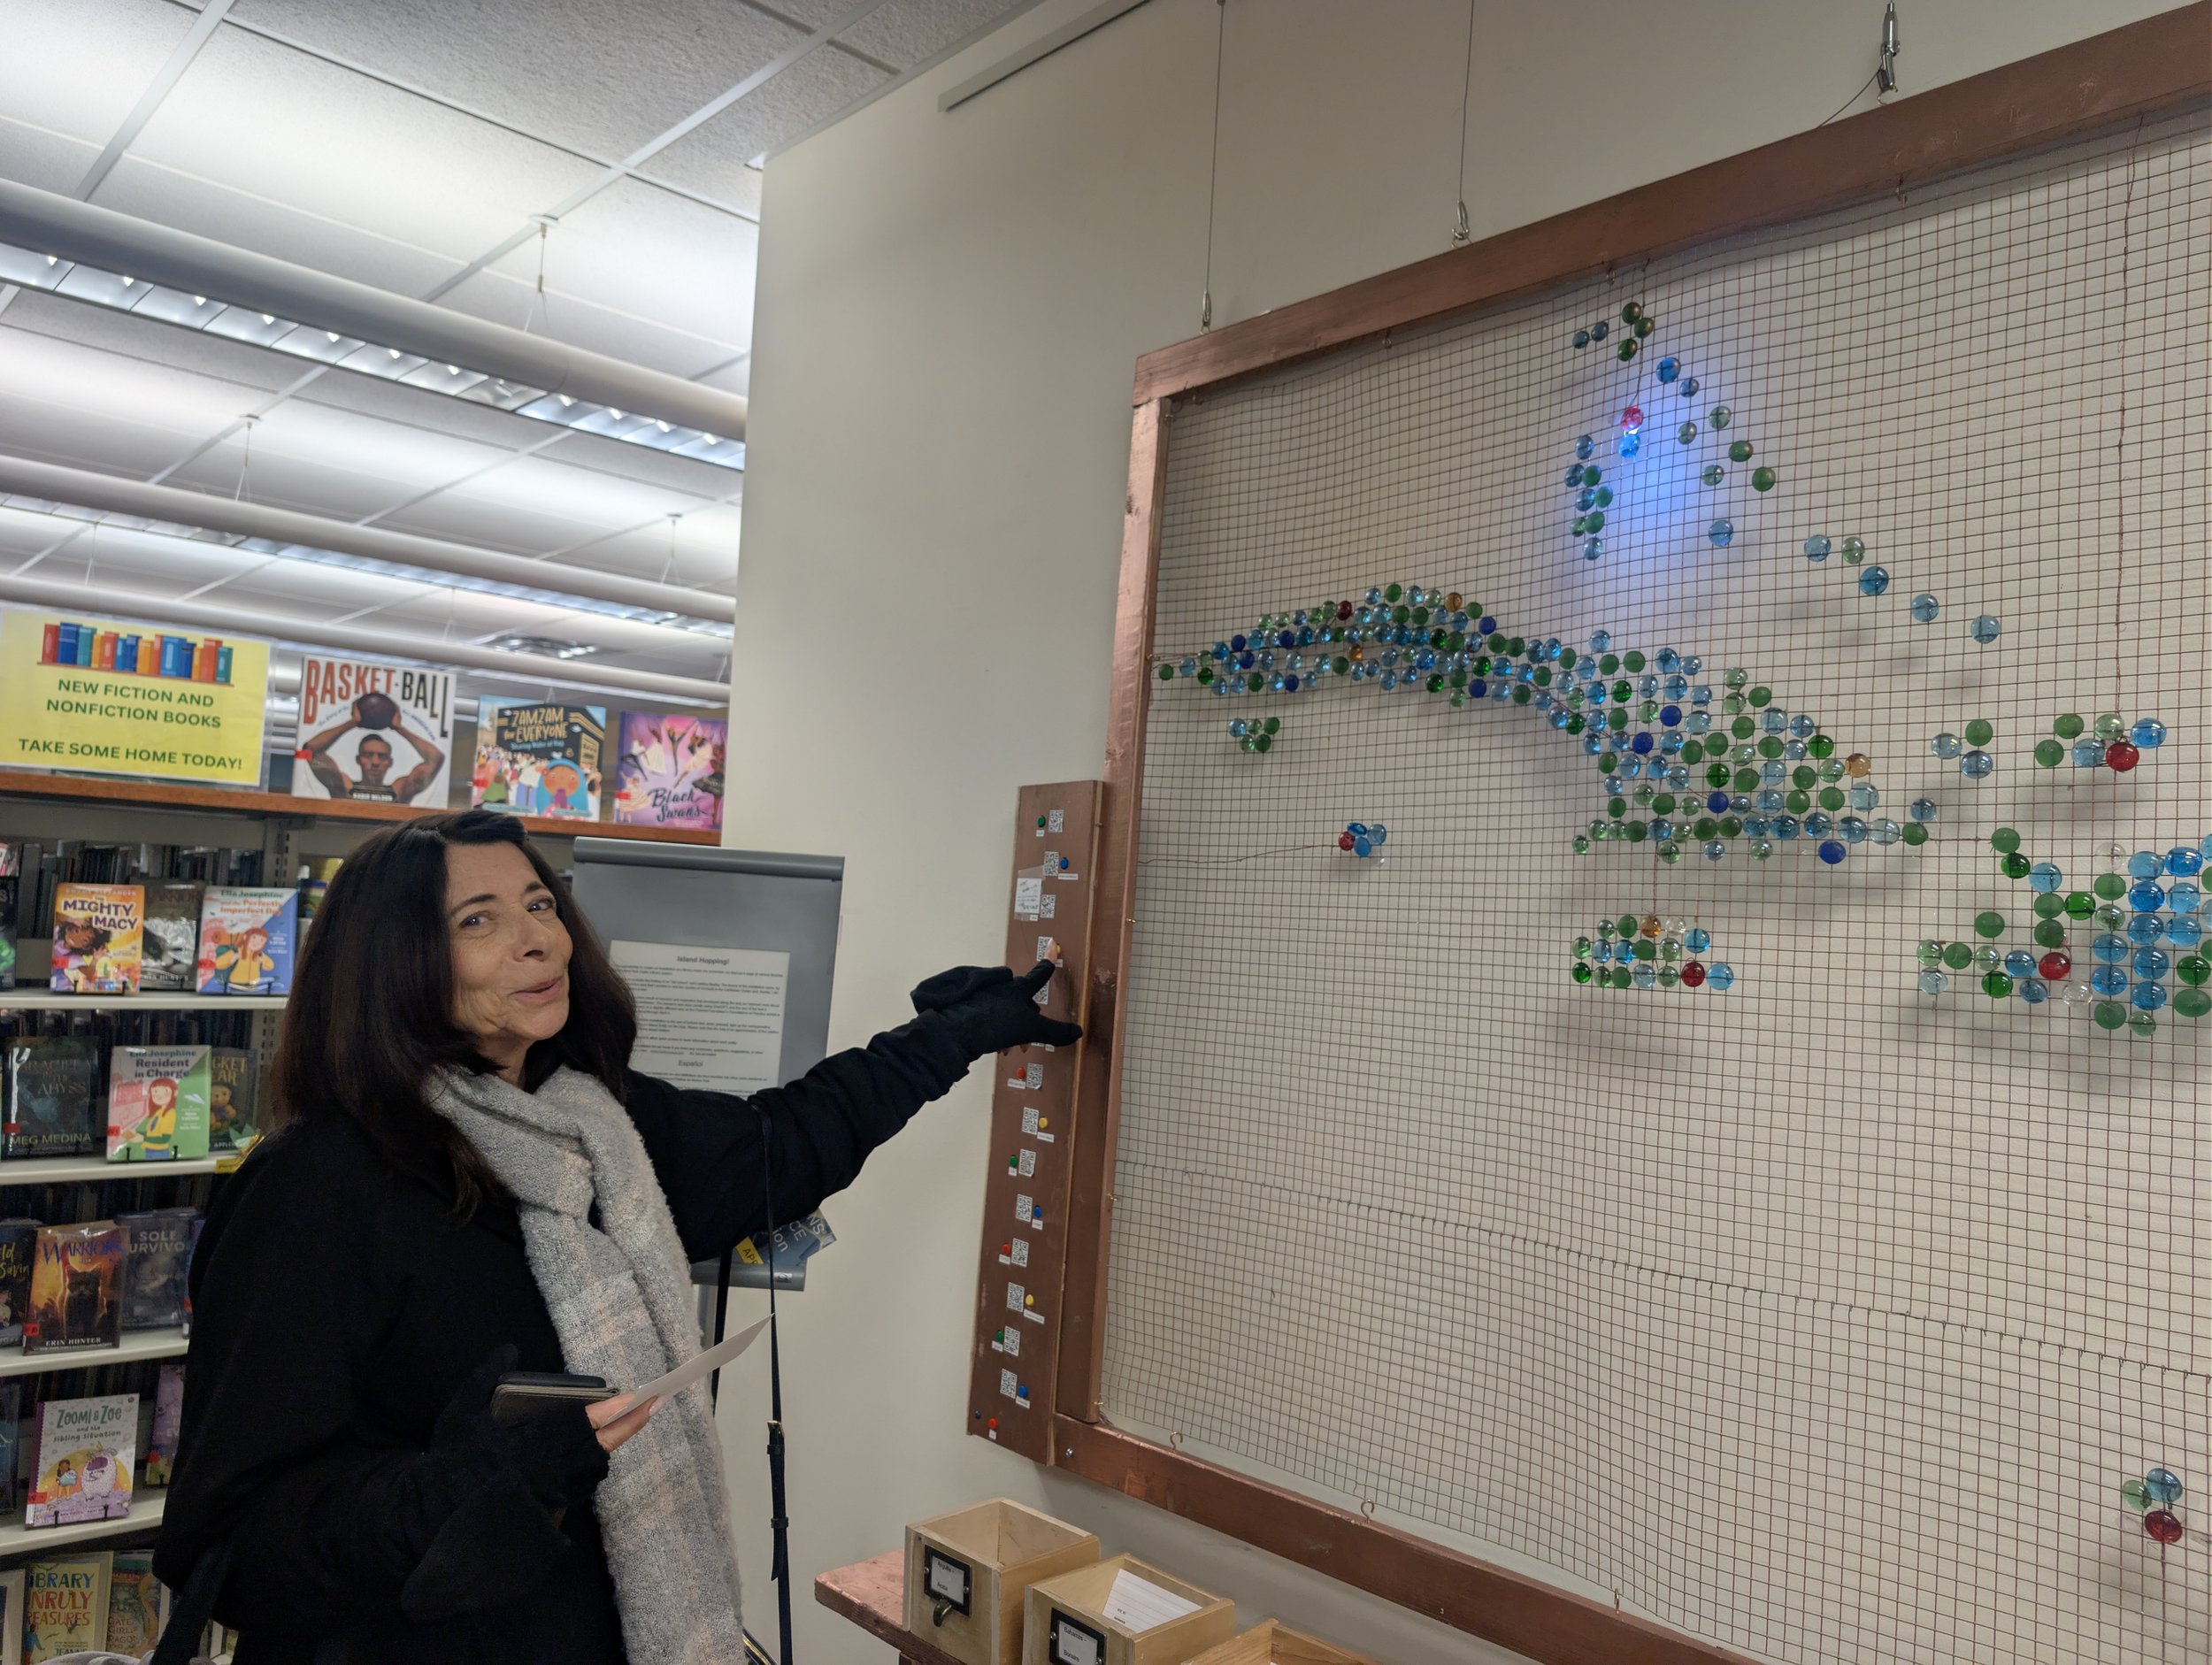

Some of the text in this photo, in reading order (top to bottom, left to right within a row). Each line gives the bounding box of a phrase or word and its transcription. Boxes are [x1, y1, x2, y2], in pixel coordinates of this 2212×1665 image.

[58, 679, 214, 707] NEW FICTION AND
[47, 699, 221, 728] NONFICTION BOOKS
[511, 707, 565, 728] ZAMZAM
[516, 722, 569, 742] EVERYONE
[19, 738, 242, 770] TAKE SOME HOME TODAY!
[648, 787, 699, 808] Black
[657, 805, 707, 823] Swans
[63, 900, 134, 917] MIGHTY
[94, 917, 138, 930] MACY
[699, 956, 730, 966] Hopping!
[148, 1049, 196, 1058] Josephine
[135, 1058, 189, 1068] Resident
[678, 1059, 703, 1068] Español
[146, 1069, 189, 1079] Charge
[12, 1132, 91, 1146] MEG MEDINA
[139, 1230, 178, 1242] SOLE
[129, 1240, 185, 1255] URVIVO
[0, 1262, 29, 1279] Savin
[68, 1337, 101, 1346] HUNTER
[29, 1572, 95, 1588] IBRARY
[27, 1611, 91, 1626] REASURES
[1064, 1626, 1083, 1642] Bahamas
